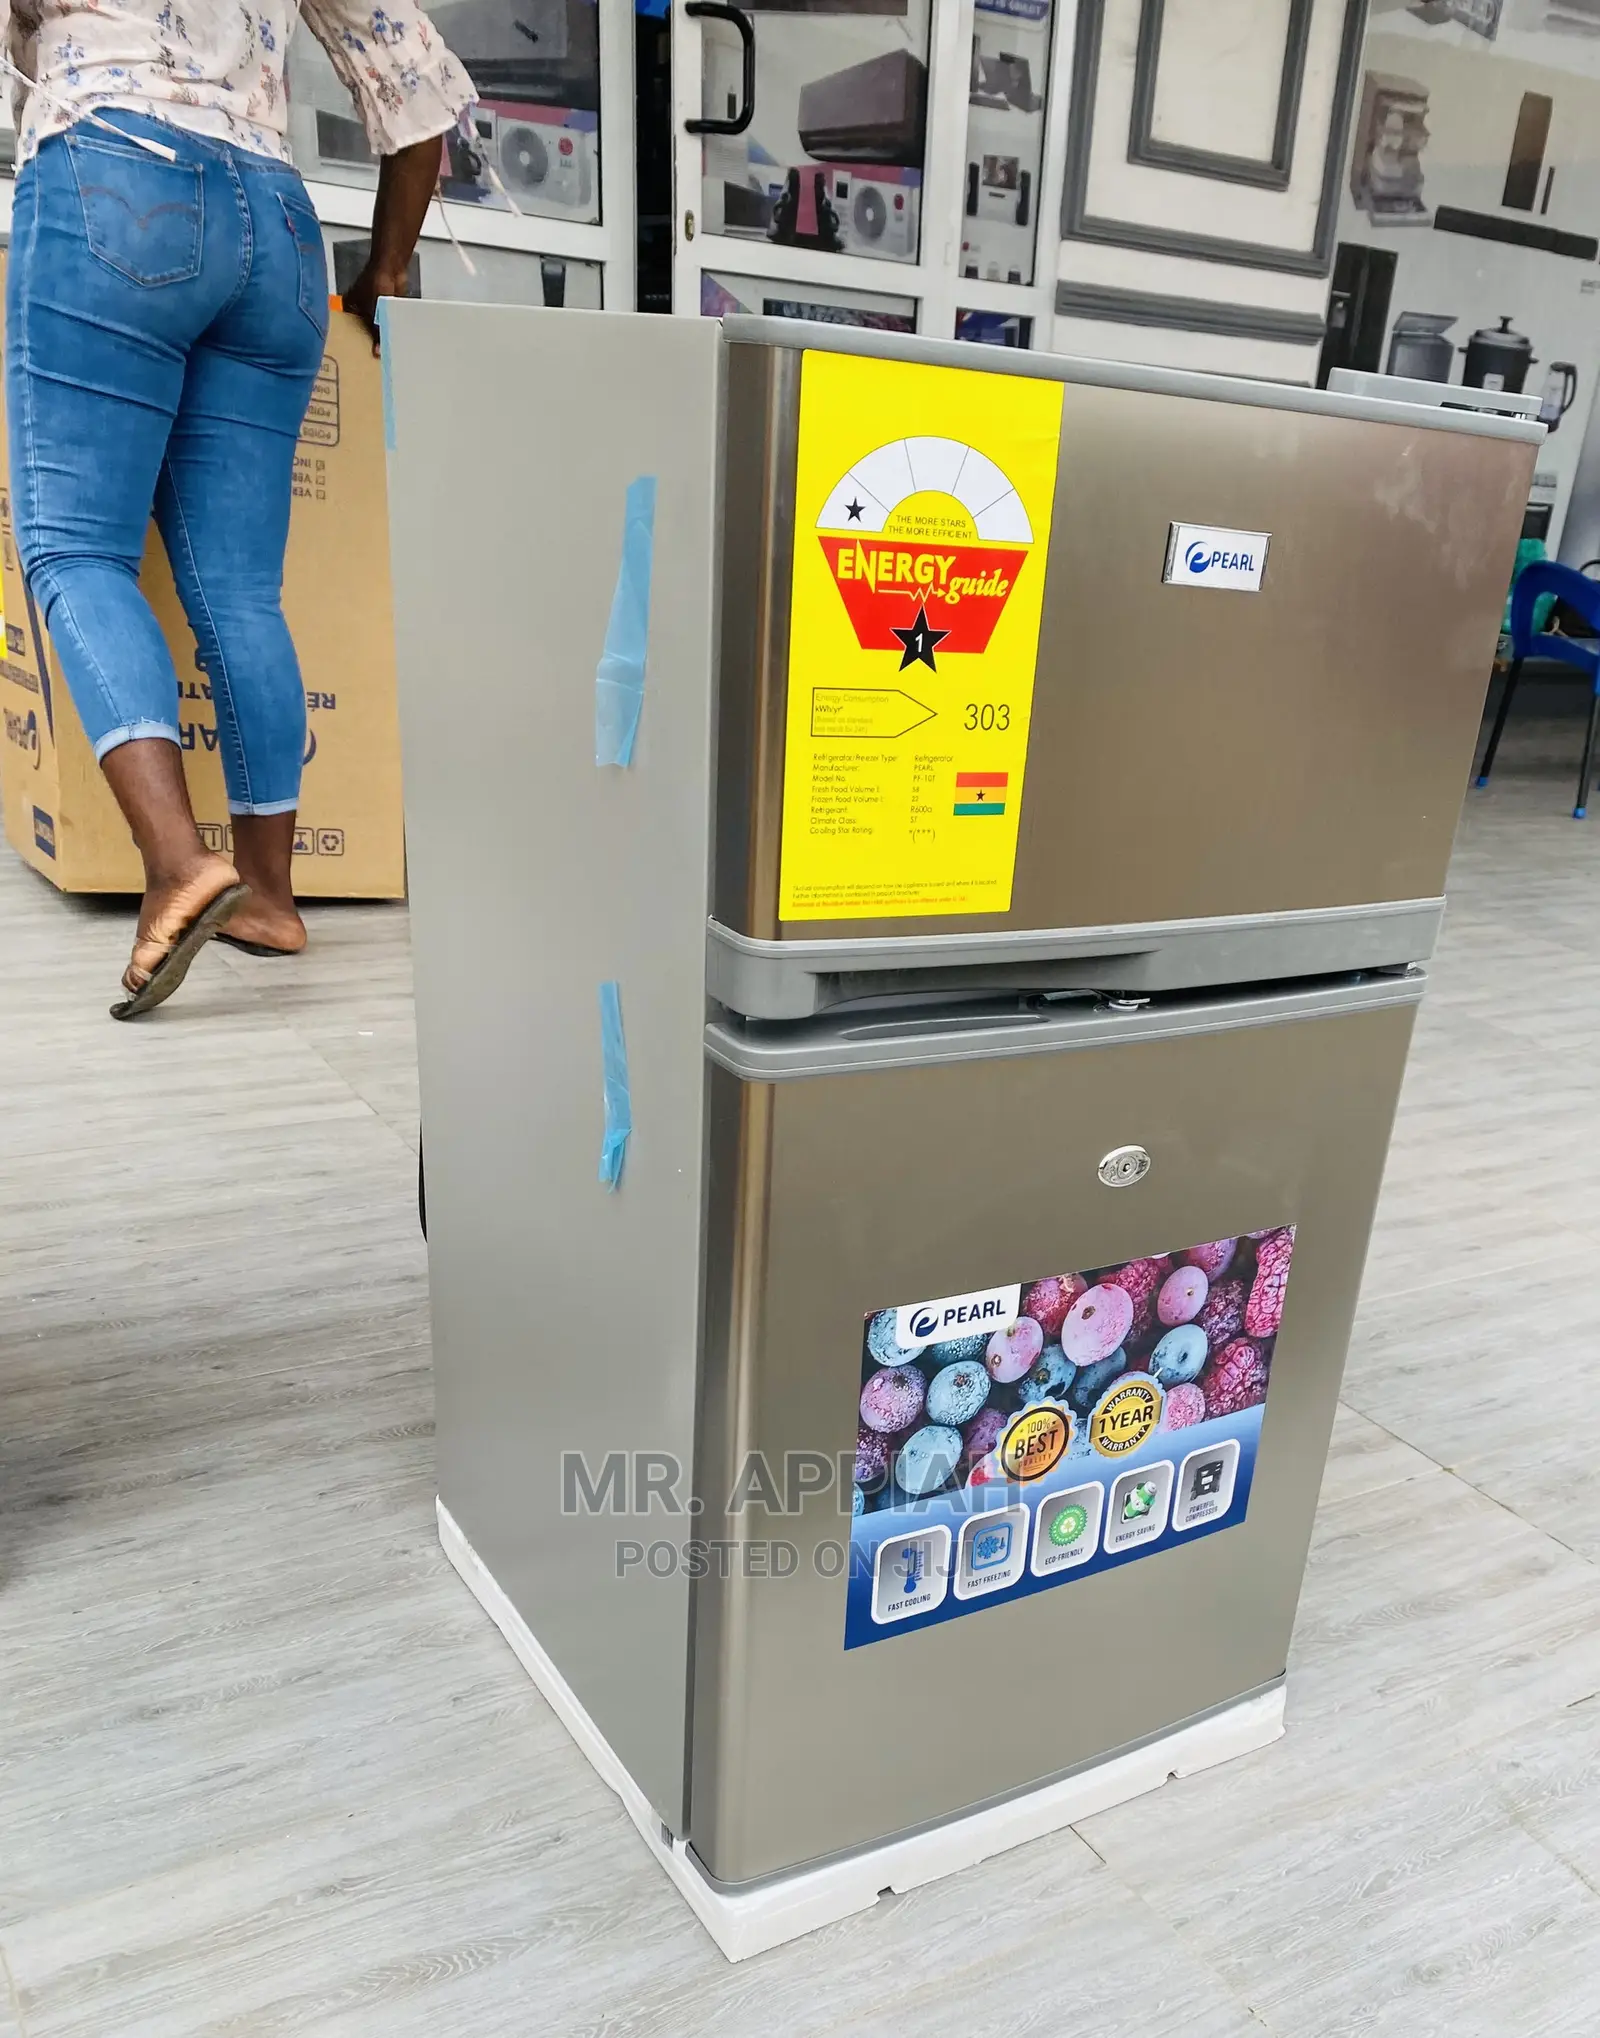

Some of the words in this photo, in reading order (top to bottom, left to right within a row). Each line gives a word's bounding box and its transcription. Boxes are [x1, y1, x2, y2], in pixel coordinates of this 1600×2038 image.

[896, 515, 912, 524] THE
[915, 516, 938, 526] MORE
[941, 518, 966, 528] STARS
[888, 526, 904, 535] THE
[906, 527, 931, 536] MORE
[933, 528, 972, 539] EFFICIENT
[1211, 550, 1254, 572] PEARL
[837, 540, 956, 594] ENERGY
[945, 568, 1009, 604] guide
[914, 633, 923, 653] 1
[964, 703, 1011, 731] 303
[914, 754, 953, 764] Refrigerator
[914, 764, 934, 772] PEARL
[812, 774, 833, 782] Model
[831, 785, 848, 793] Food
[850, 785, 875, 793] Volume
[835, 795, 851, 803] Food
[854, 795, 878, 803] Volume
[810, 816, 836, 825] Climate
[809, 826, 836, 835] Cooling
[943, 1299, 1006, 1326] PEARL
[1106, 1387, 1152, 1412] WARRANTY
[1027, 1417, 1051, 1434] 100%
[1109, 1405, 1154, 1430] YEAR
[1014, 1429, 1058, 1460] BEST
[1101, 1427, 1147, 1452] WARRANTY
[1115, 1530, 1135, 1543] ENERGY
[1136, 1524, 1156, 1536] SAVING
[1045, 1547, 1084, 1565] ECO-FRIENDLY
[967, 1578, 982, 1588] FAST
[983, 1569, 1012, 1584] FREEZING
[888, 1601, 904, 1612] FAST
[904, 1593, 931, 1607] COOLING
